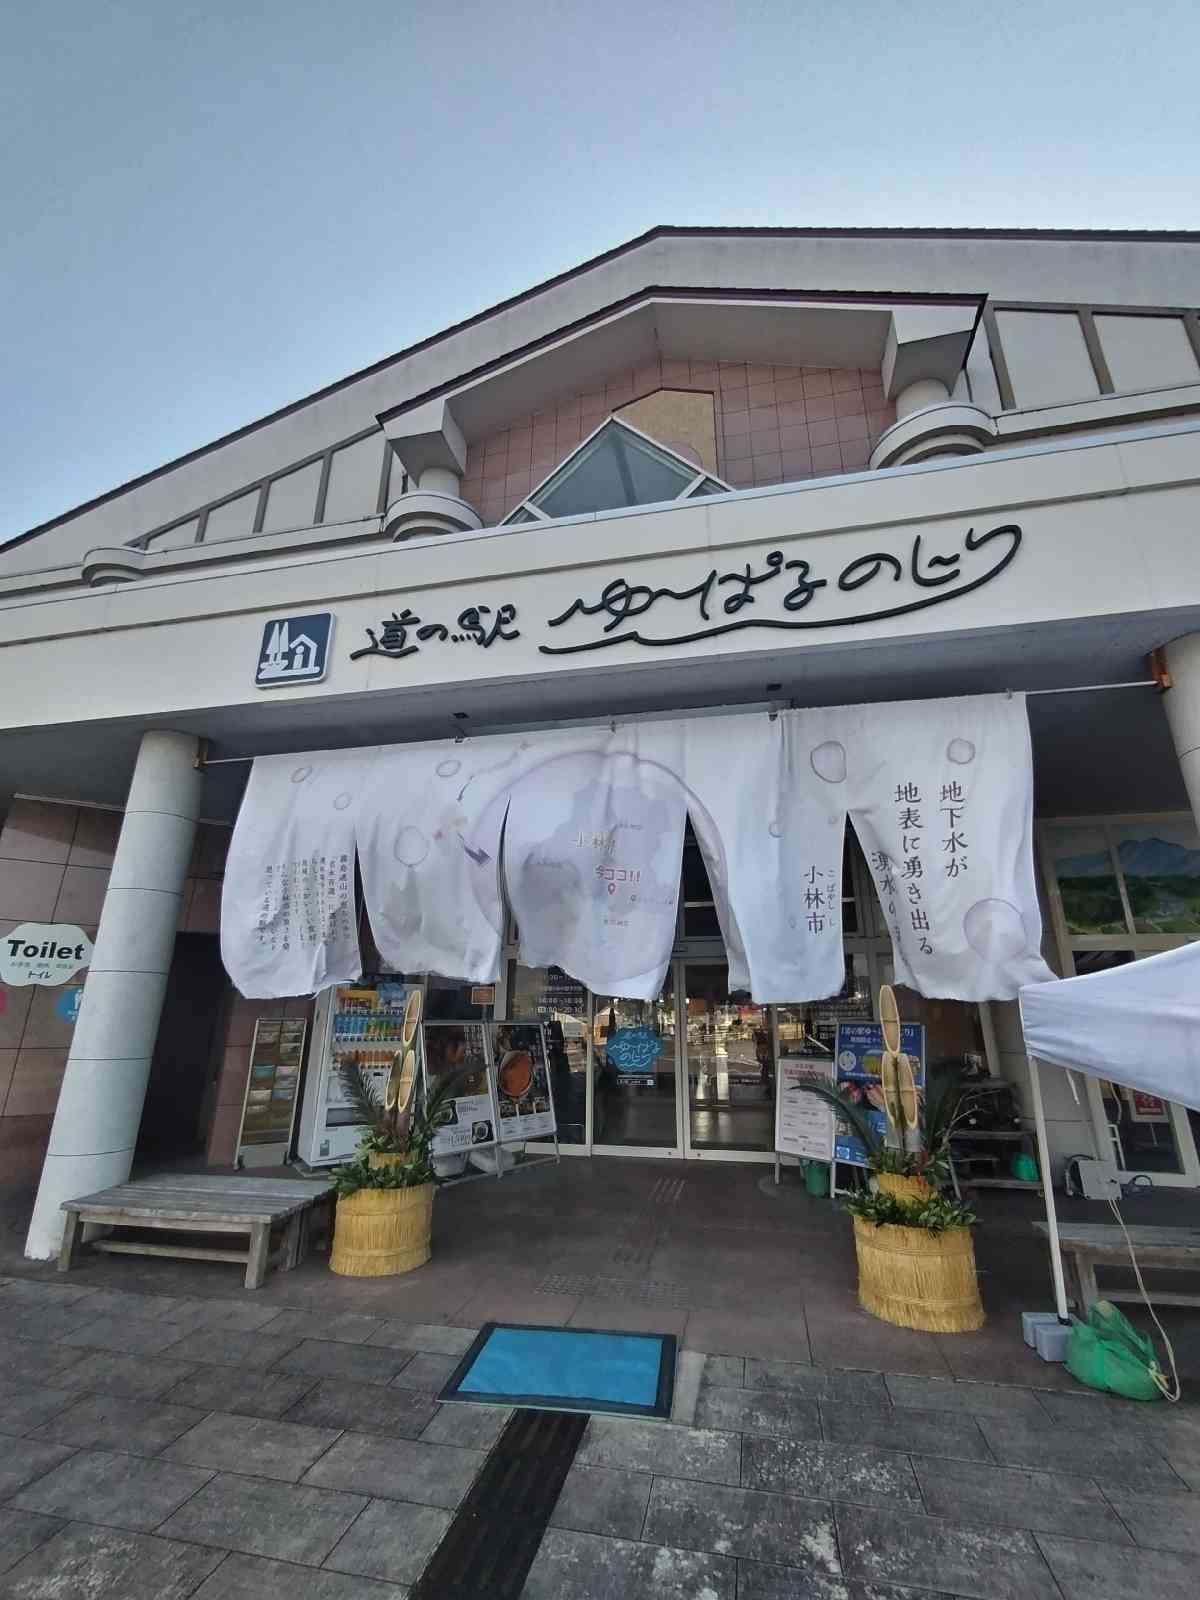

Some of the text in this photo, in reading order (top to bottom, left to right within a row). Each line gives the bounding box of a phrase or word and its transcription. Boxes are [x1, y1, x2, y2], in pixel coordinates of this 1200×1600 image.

[350, 604, 520, 660] 道の駅
[940, 781, 968, 878] 地下水が
[803, 865, 826, 934] 小林市
[7, 939, 85, 960] Toilet
[27, 971, 53, 979] トイレ
